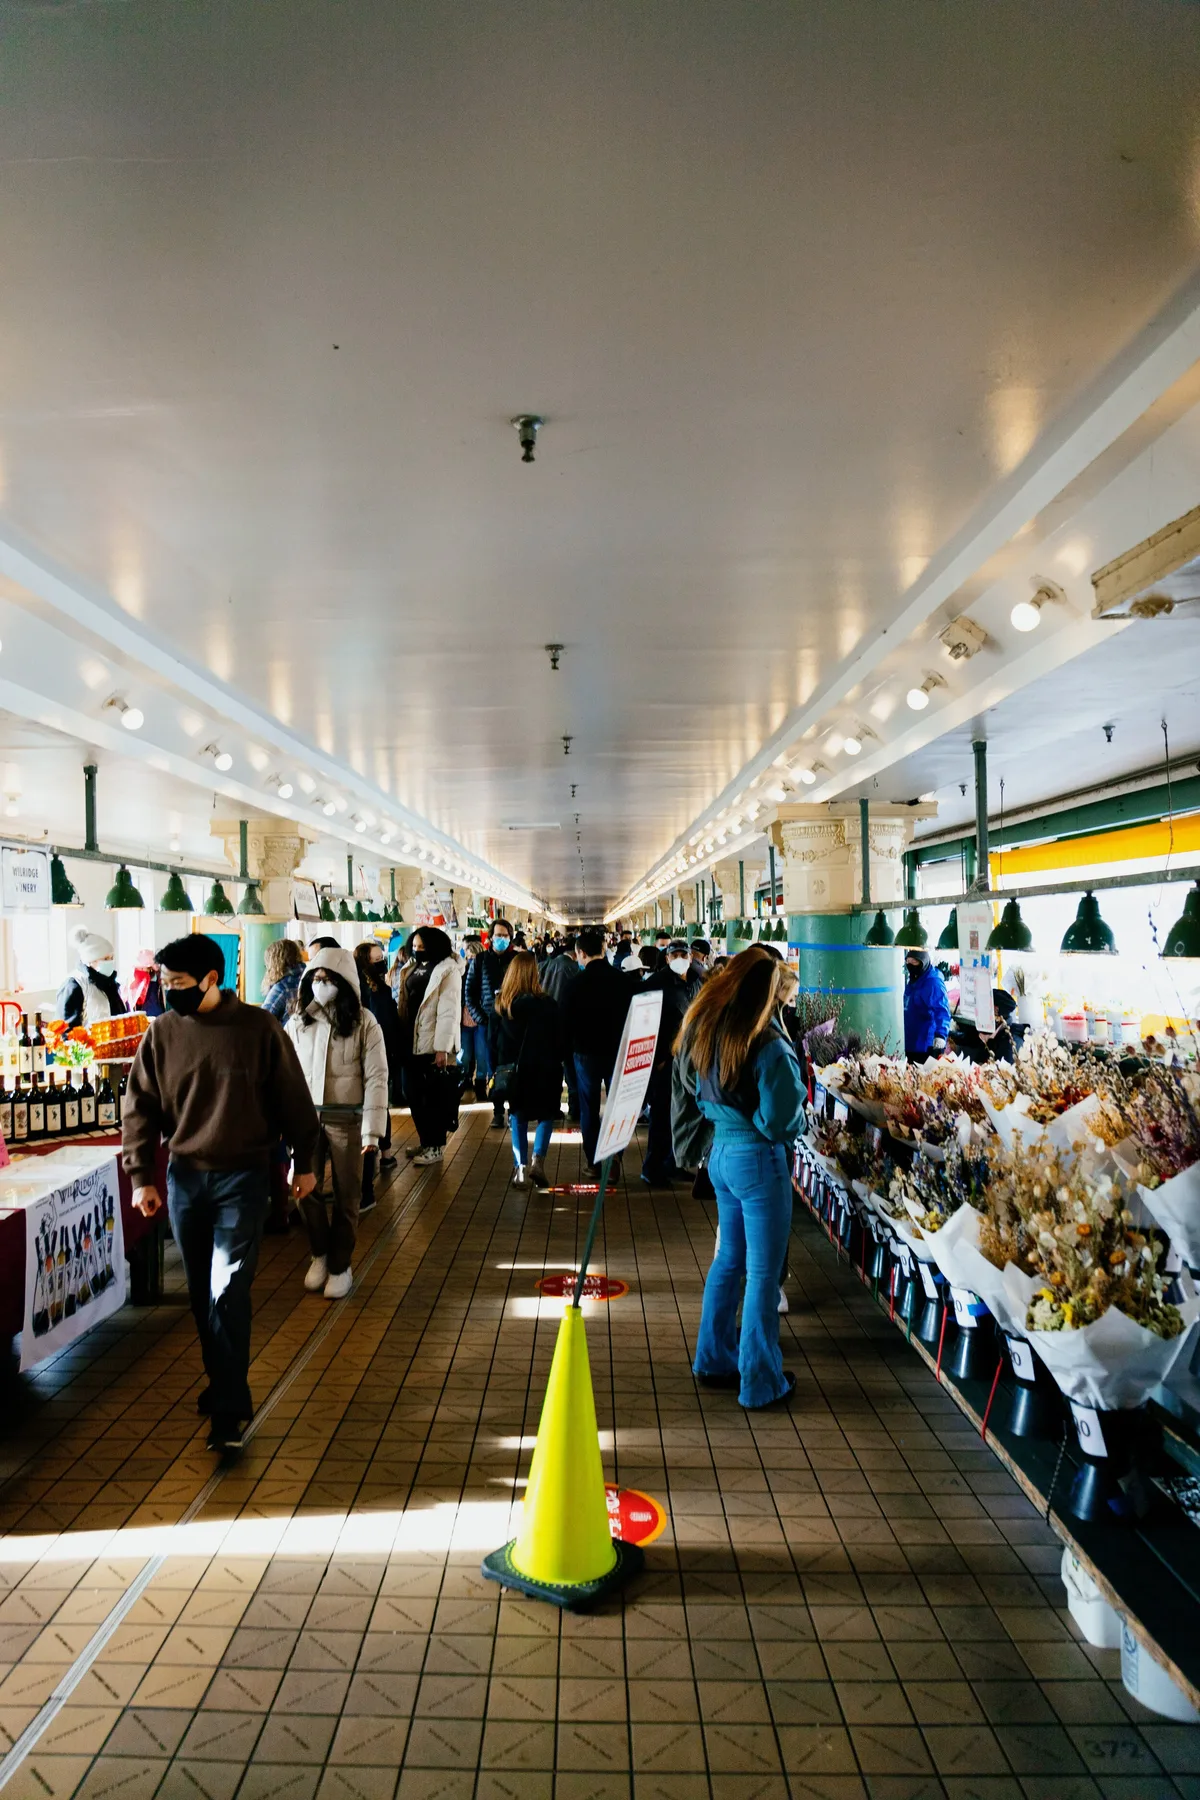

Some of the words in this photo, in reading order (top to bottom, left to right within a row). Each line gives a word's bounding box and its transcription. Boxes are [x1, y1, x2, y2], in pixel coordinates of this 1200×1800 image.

[12, 866, 39, 878] WILRIDGE
[629, 1038, 655, 1057] ATTENTION
[625, 1050, 653, 1073] SHOPPERS
